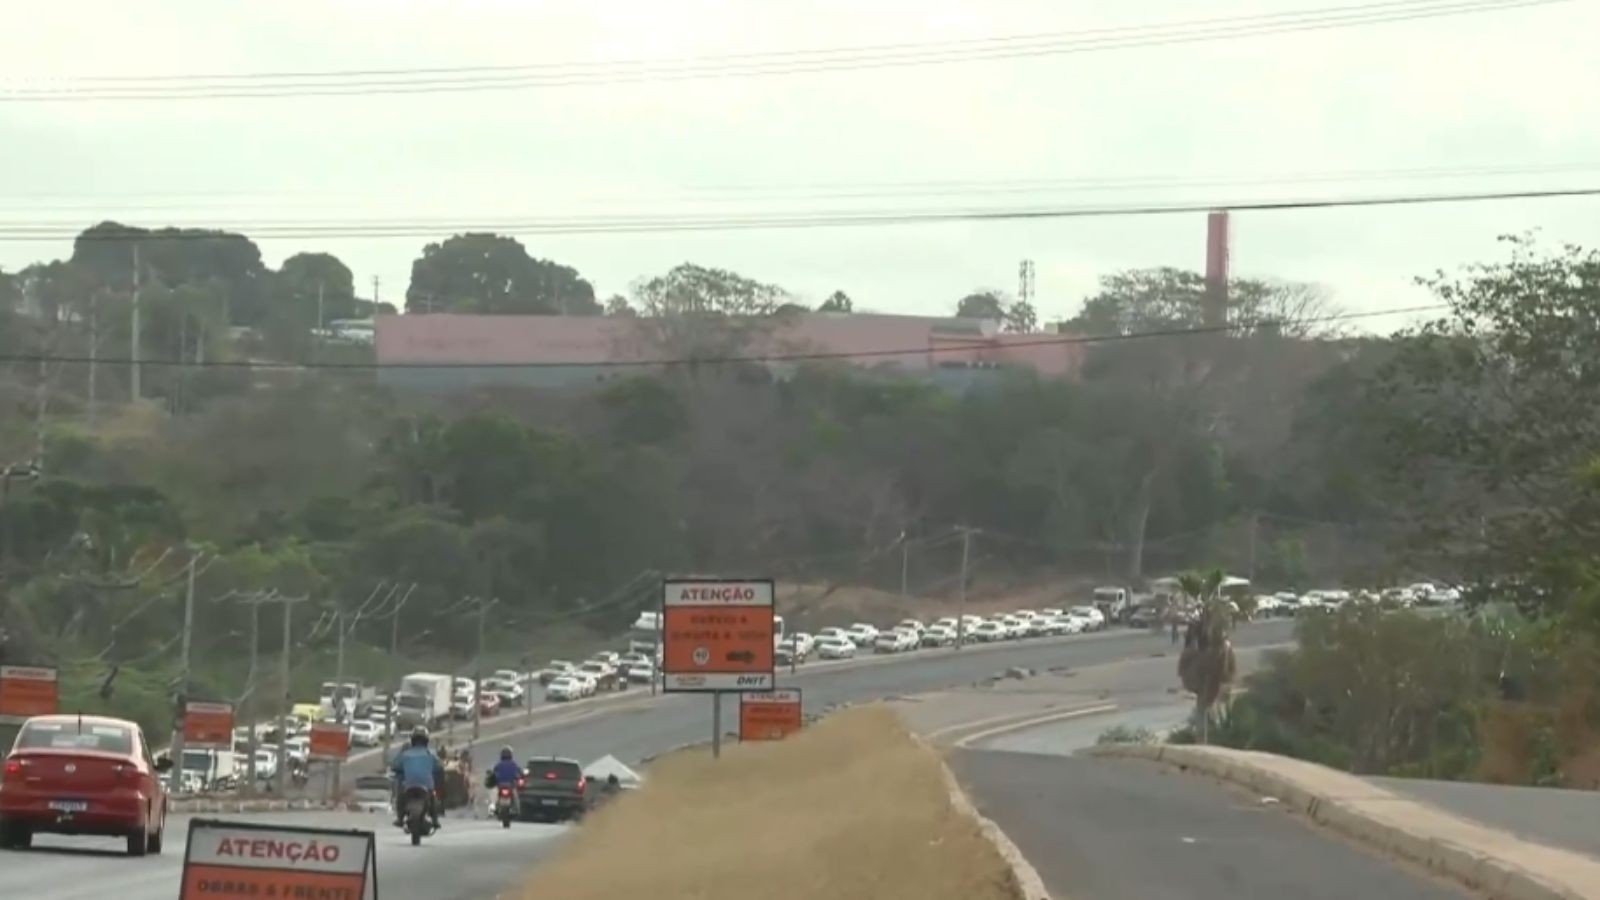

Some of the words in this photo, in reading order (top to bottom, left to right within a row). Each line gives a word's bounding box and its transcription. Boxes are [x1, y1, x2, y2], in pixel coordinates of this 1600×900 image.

[681, 588, 754, 602] ATENÇÃO
[737, 676, 766, 685] DNIT
[217, 838, 339, 864] ATENÇÃO
